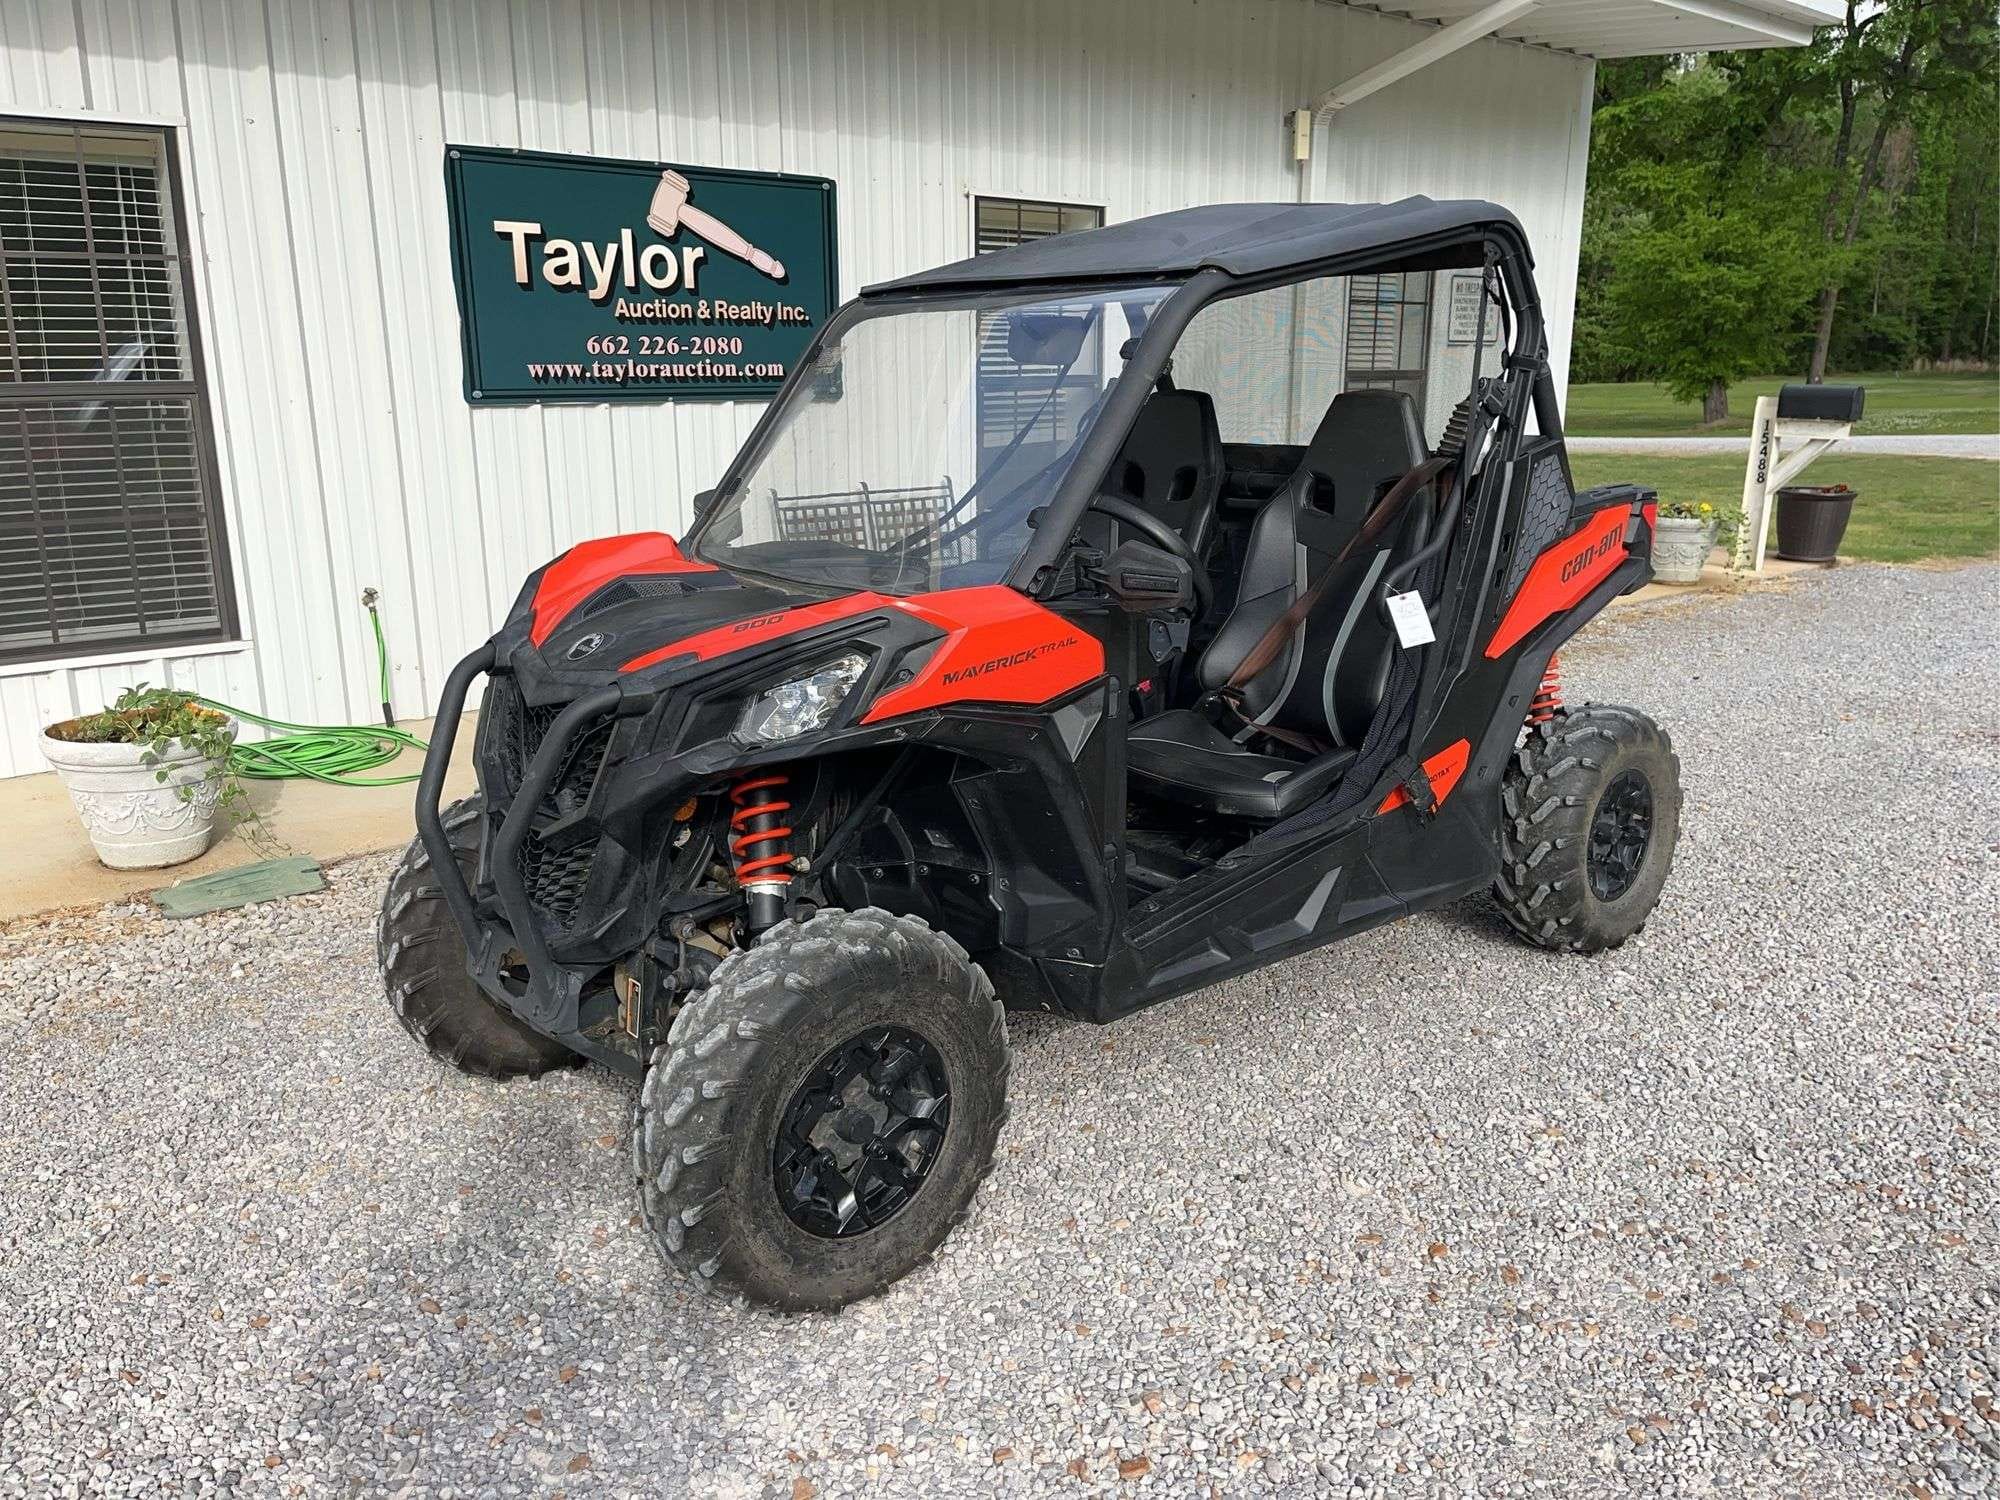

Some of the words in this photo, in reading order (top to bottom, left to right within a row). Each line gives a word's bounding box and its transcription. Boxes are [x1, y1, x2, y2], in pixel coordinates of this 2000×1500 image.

[493, 220, 705, 300] Taylor
[614, 298, 693, 319] Auction
[697, 300, 711, 319] &
[714, 300, 774, 324] Realty
[777, 302, 810, 321] Inc.
[586, 335, 630, 355] 662
[637, 335, 744, 356] 226-2080
[526, 358, 785, 382] www.taylorauction.com
[1756, 418, 1770, 484] 15488
[1561, 523, 1623, 583] can-am
[733, 614, 785, 633] 800
[942, 647, 1039, 686] MAVERICK
[1039, 637, 1078, 655] TRAIL
